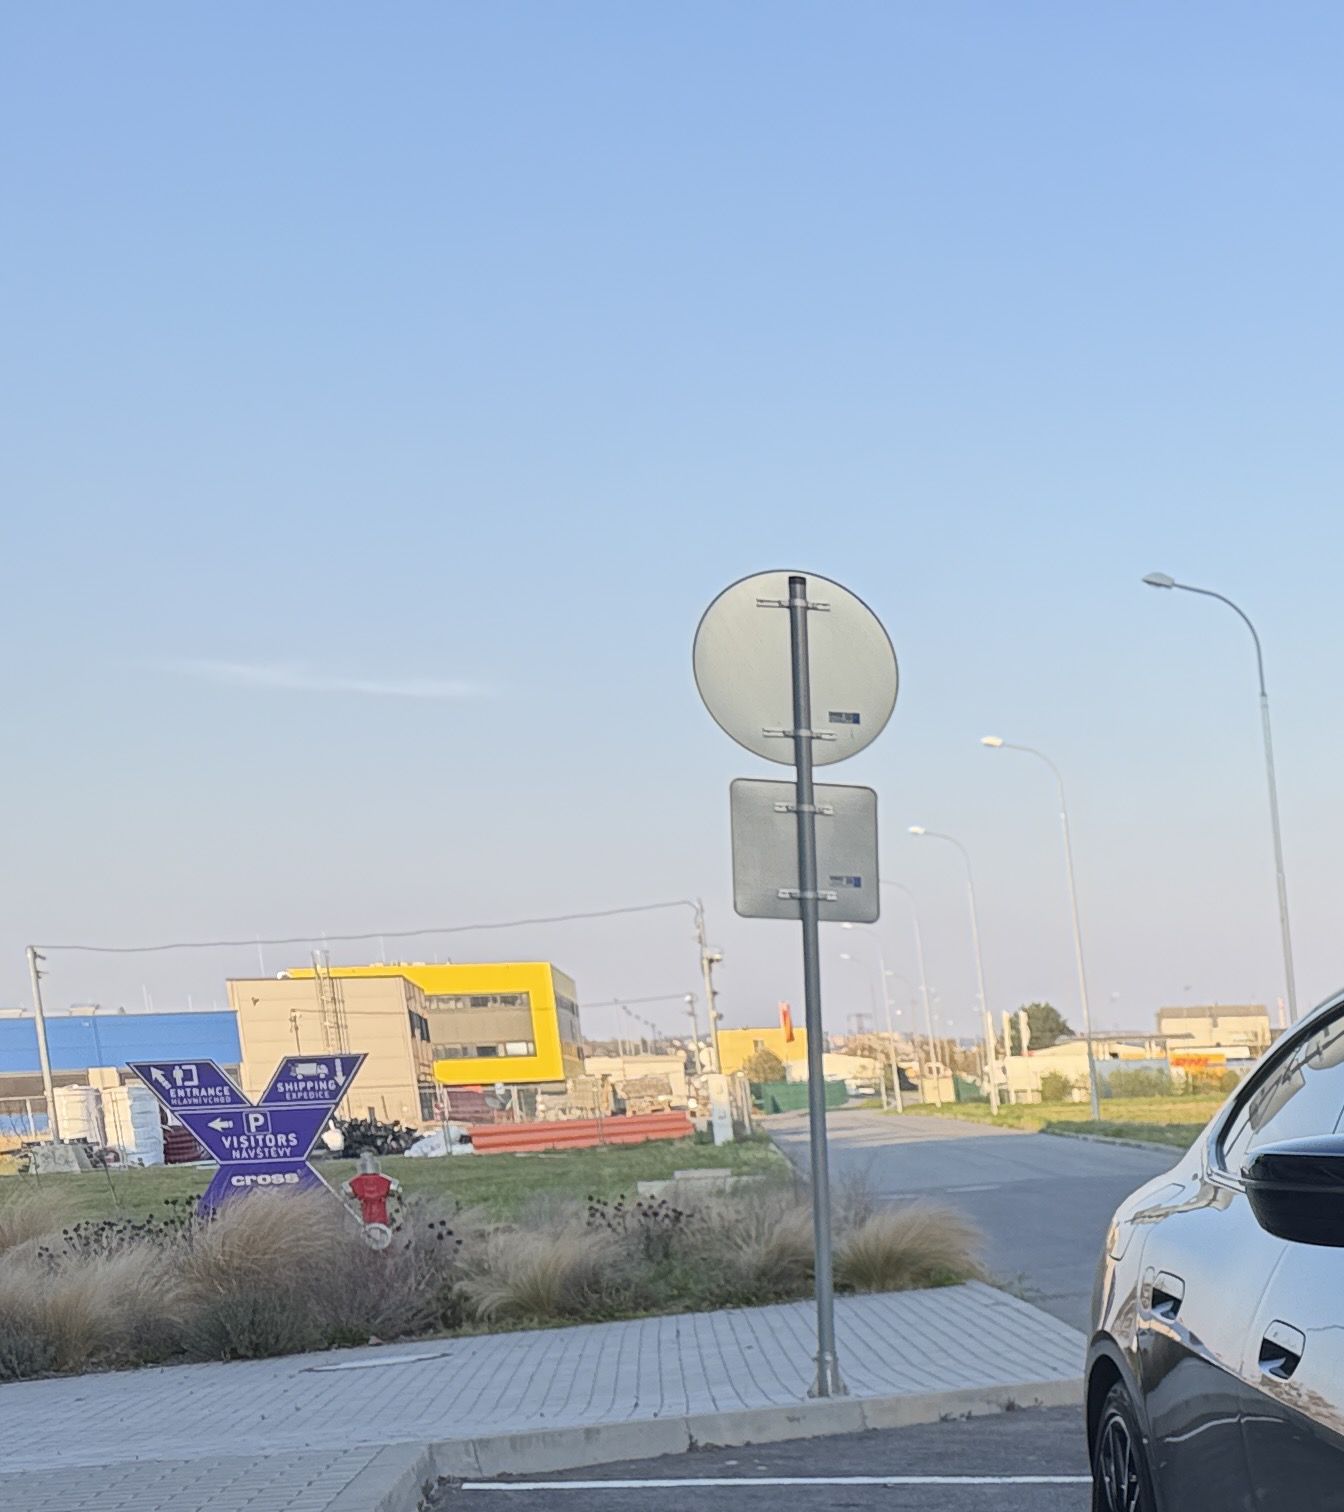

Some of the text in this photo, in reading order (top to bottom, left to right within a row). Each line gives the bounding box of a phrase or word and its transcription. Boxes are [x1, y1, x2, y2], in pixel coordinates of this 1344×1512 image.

[169, 1086, 230, 1098] ENTRANCE
[276, 1080, 337, 1093] SHIPPING
[248, 1113, 265, 1133] P
[221, 1133, 298, 1148] VISITORS
[231, 1173, 299, 1186] cross
